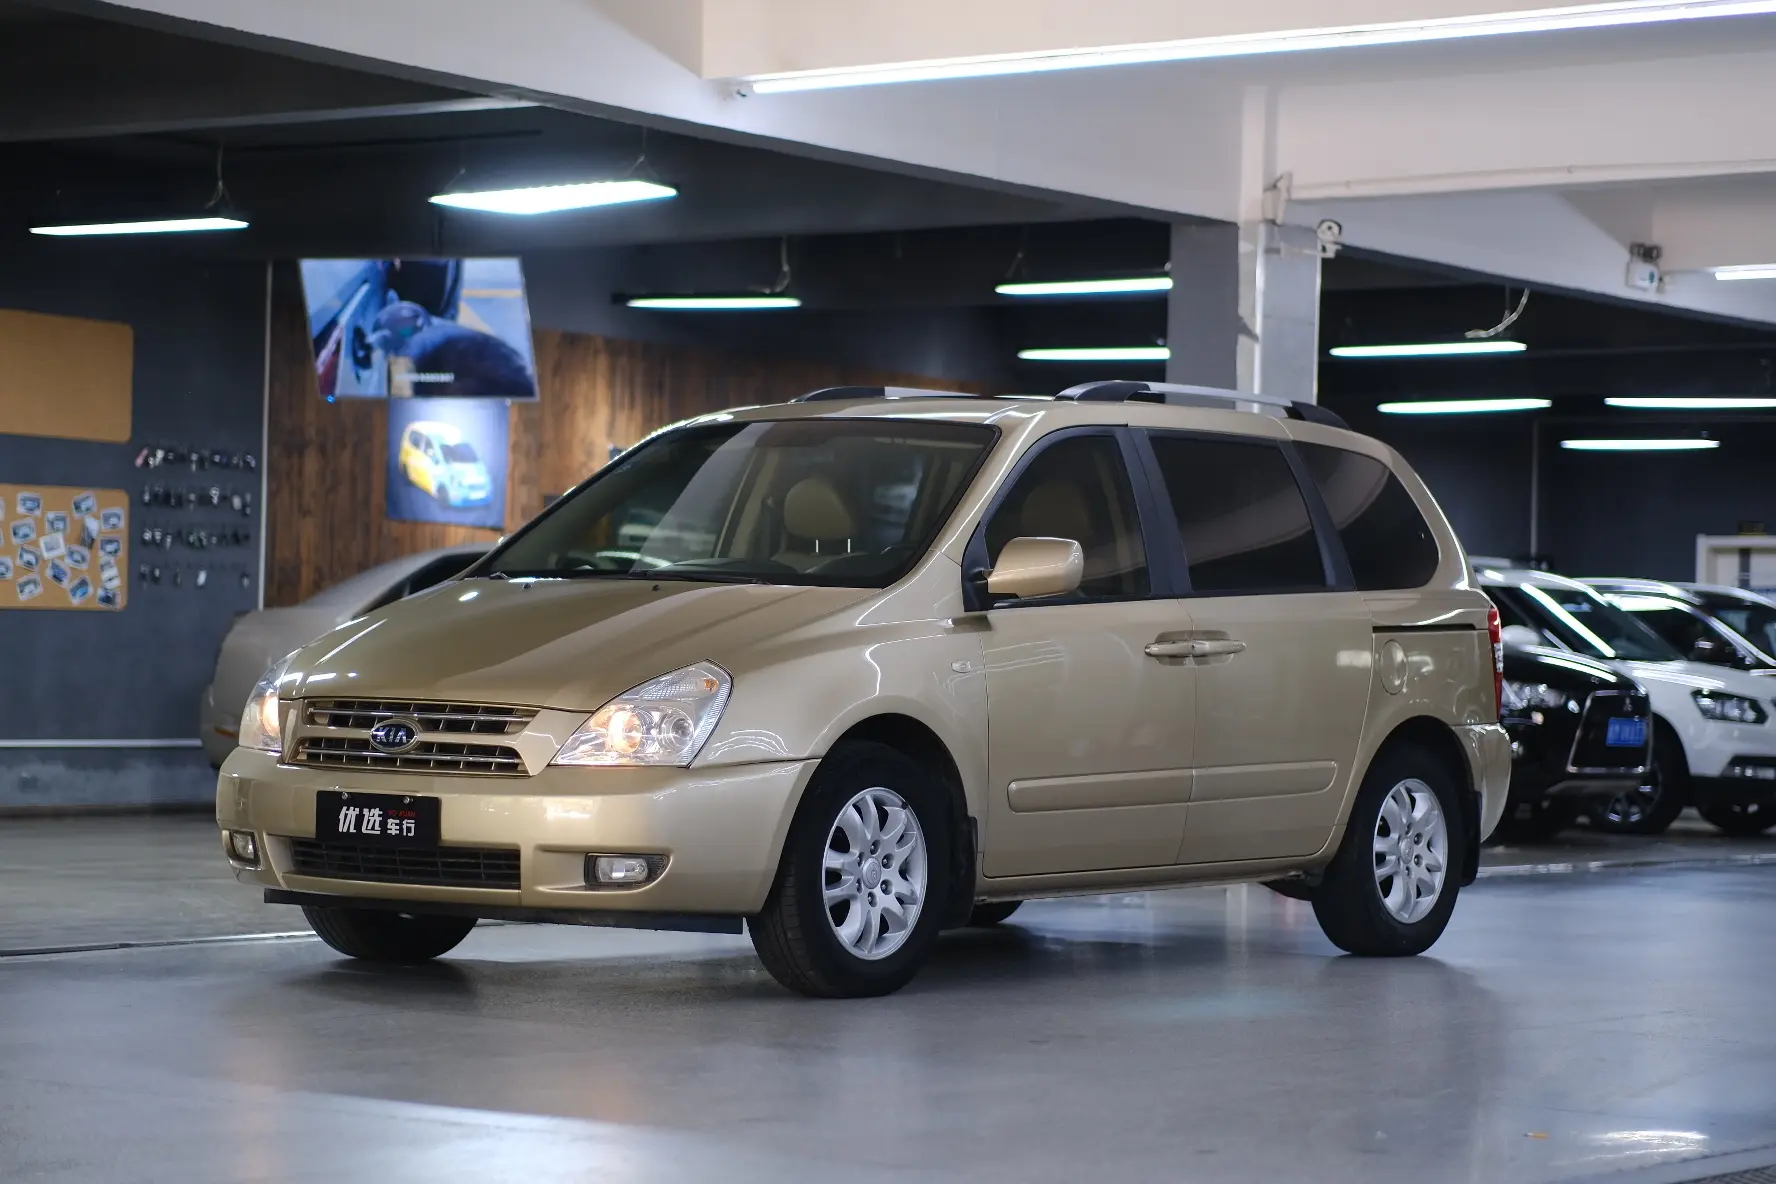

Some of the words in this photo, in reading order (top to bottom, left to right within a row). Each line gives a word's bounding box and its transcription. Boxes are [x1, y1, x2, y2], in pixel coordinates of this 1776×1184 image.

[376, 727, 407, 743] KIA
[338, 806, 383, 835] 优选
[387, 818, 415, 836] 车行
